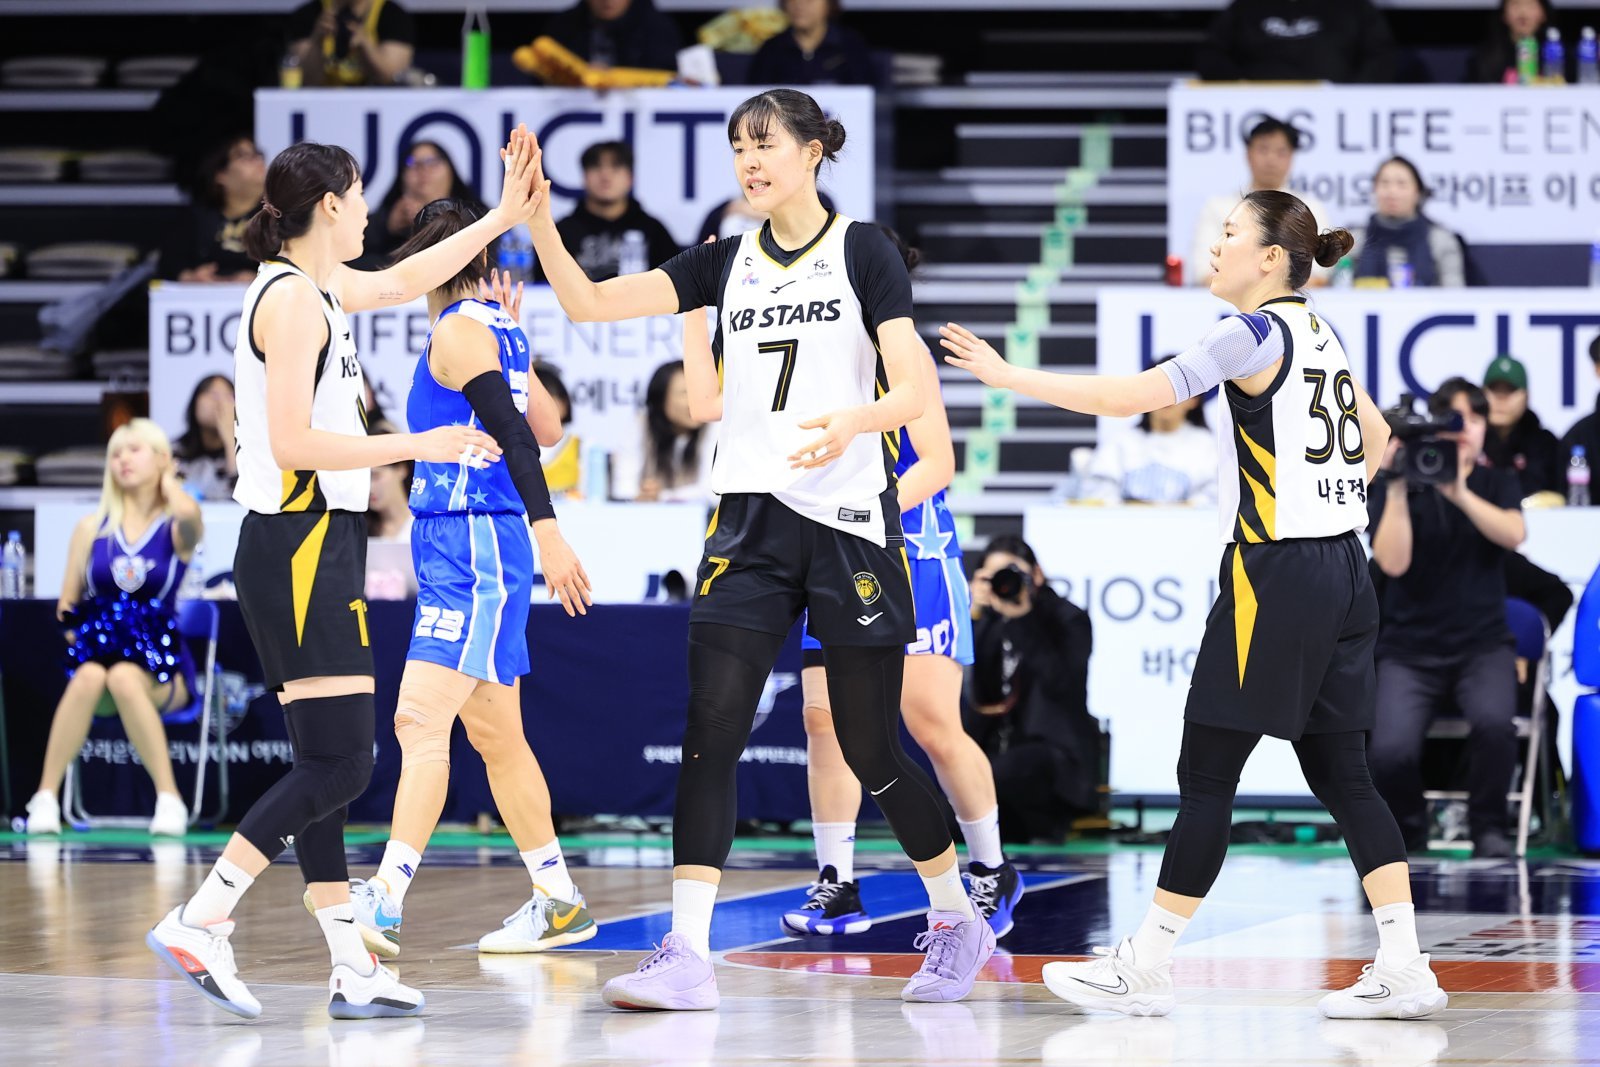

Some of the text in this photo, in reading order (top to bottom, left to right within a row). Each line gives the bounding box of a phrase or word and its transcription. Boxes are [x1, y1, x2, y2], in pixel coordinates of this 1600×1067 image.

[1337, 110, 1452, 152] LIFE
[350, 312, 430, 354] IFE
[729, 299, 841, 334] KB STARS
[757, 338, 799, 413] 7
[1303, 368, 1365, 466] 38
[1317, 477, 1367, 506] 나윤정
[699, 556, 731, 597] 7
[414, 605, 466, 643] 23
[906, 618, 951, 655] 20
